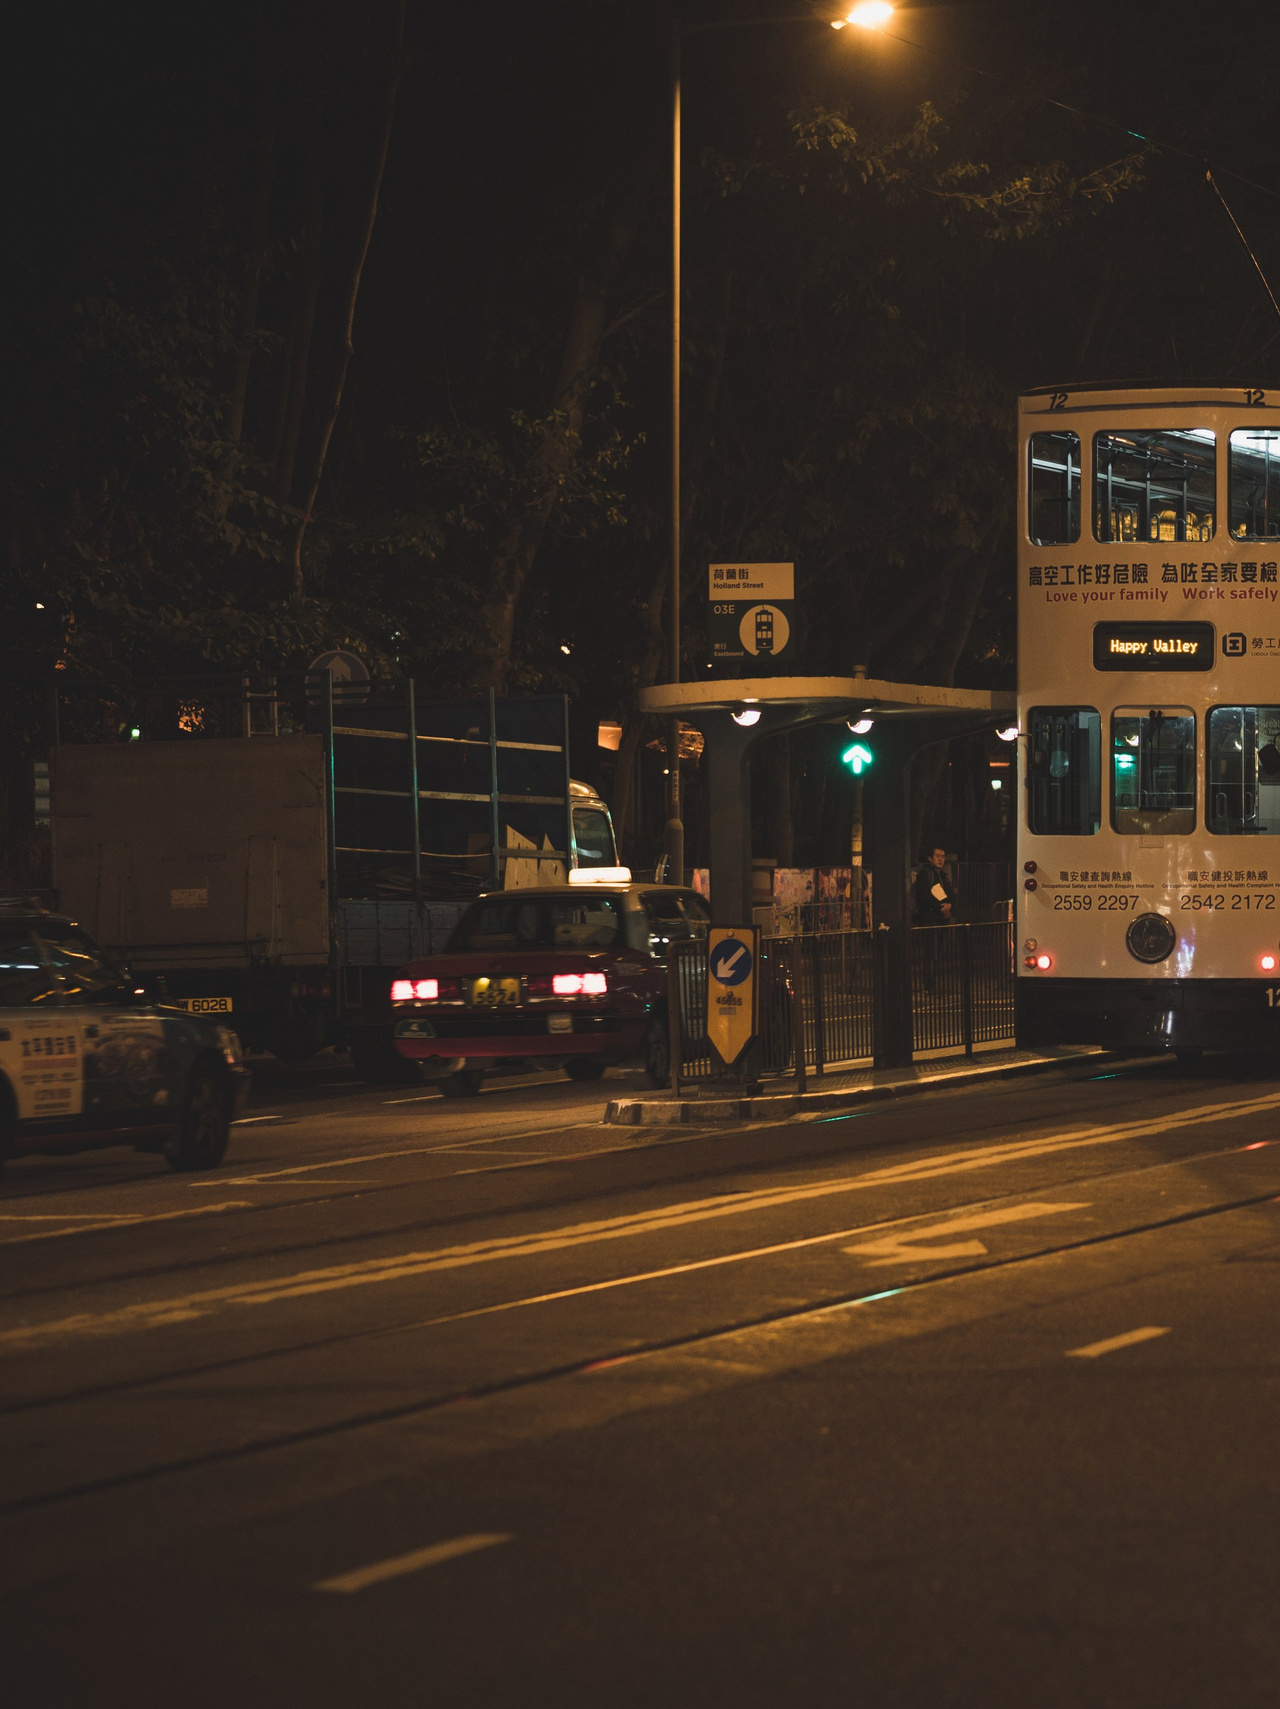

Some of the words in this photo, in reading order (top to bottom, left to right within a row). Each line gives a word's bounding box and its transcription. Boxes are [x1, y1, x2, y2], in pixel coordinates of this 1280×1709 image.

[1050, 393, 1069, 410] 12
[1244, 389, 1266, 406] 12
[713, 569, 749, 580] 荷蘭街
[1029, 563, 1149, 586] 高空工作好危險
[1046, 590, 1078, 602] Love
[1082, 590, 1116, 604] your
[1119, 587, 1169, 603] family
[1182, 587, 1225, 601] Work
[1229, 587, 1279, 602] safely
[713, 604, 735, 614] 03E
[1110, 639, 1147, 653] Happy
[1153, 639, 1198, 653] Valley
[1053, 895, 1092, 910] 2559
[1097, 895, 1140, 911] 2297
[1180, 895, 1225, 910] 2542
[1231, 894, 1276, 910] 2172
[192, 999, 228, 1012] 6028
